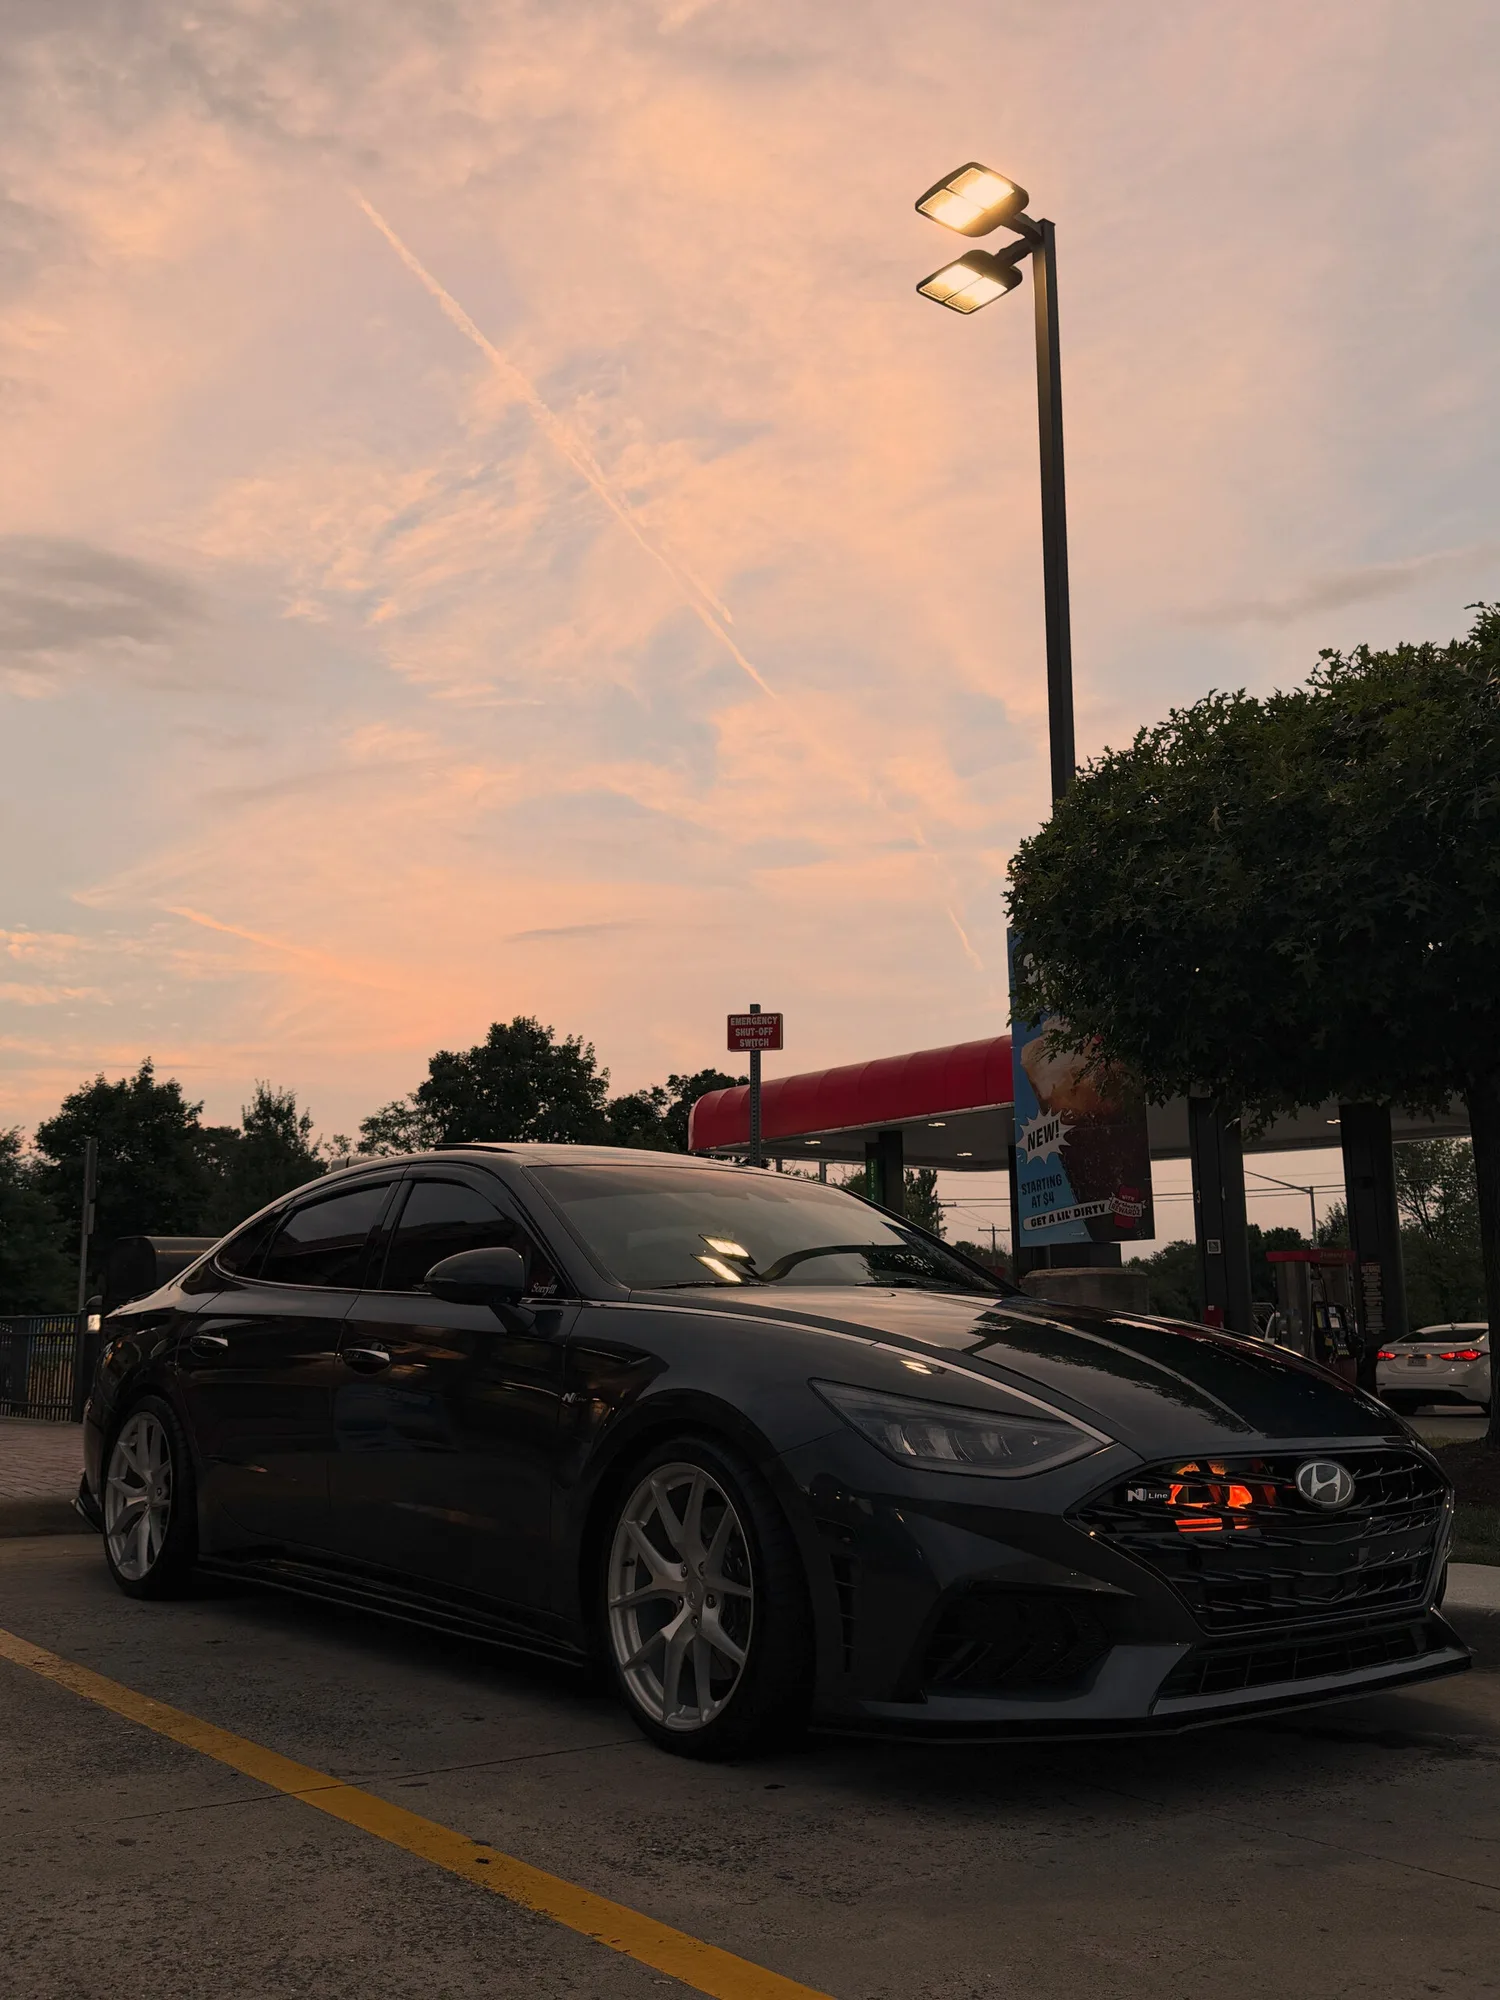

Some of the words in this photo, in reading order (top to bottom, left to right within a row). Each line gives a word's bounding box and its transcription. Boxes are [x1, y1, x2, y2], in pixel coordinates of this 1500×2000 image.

[730, 1016, 778, 1026] EMERGENCY
[735, 1027, 774, 1037] SHUT-OFF
[739, 1038, 769, 1047] SWITCH
[1027, 1120, 1059, 1152] NEW!
[1021, 1174, 1062, 1196] STARTING
[1031, 1195, 1041, 1208] AT
[1043, 1191, 1055, 1206] $4
[1030, 1216, 1047, 1228] GET
[1048, 1214, 1056, 1223] A
[1057, 1211, 1071, 1220] LIL'
[1074, 1203, 1106, 1218] DIRTY
